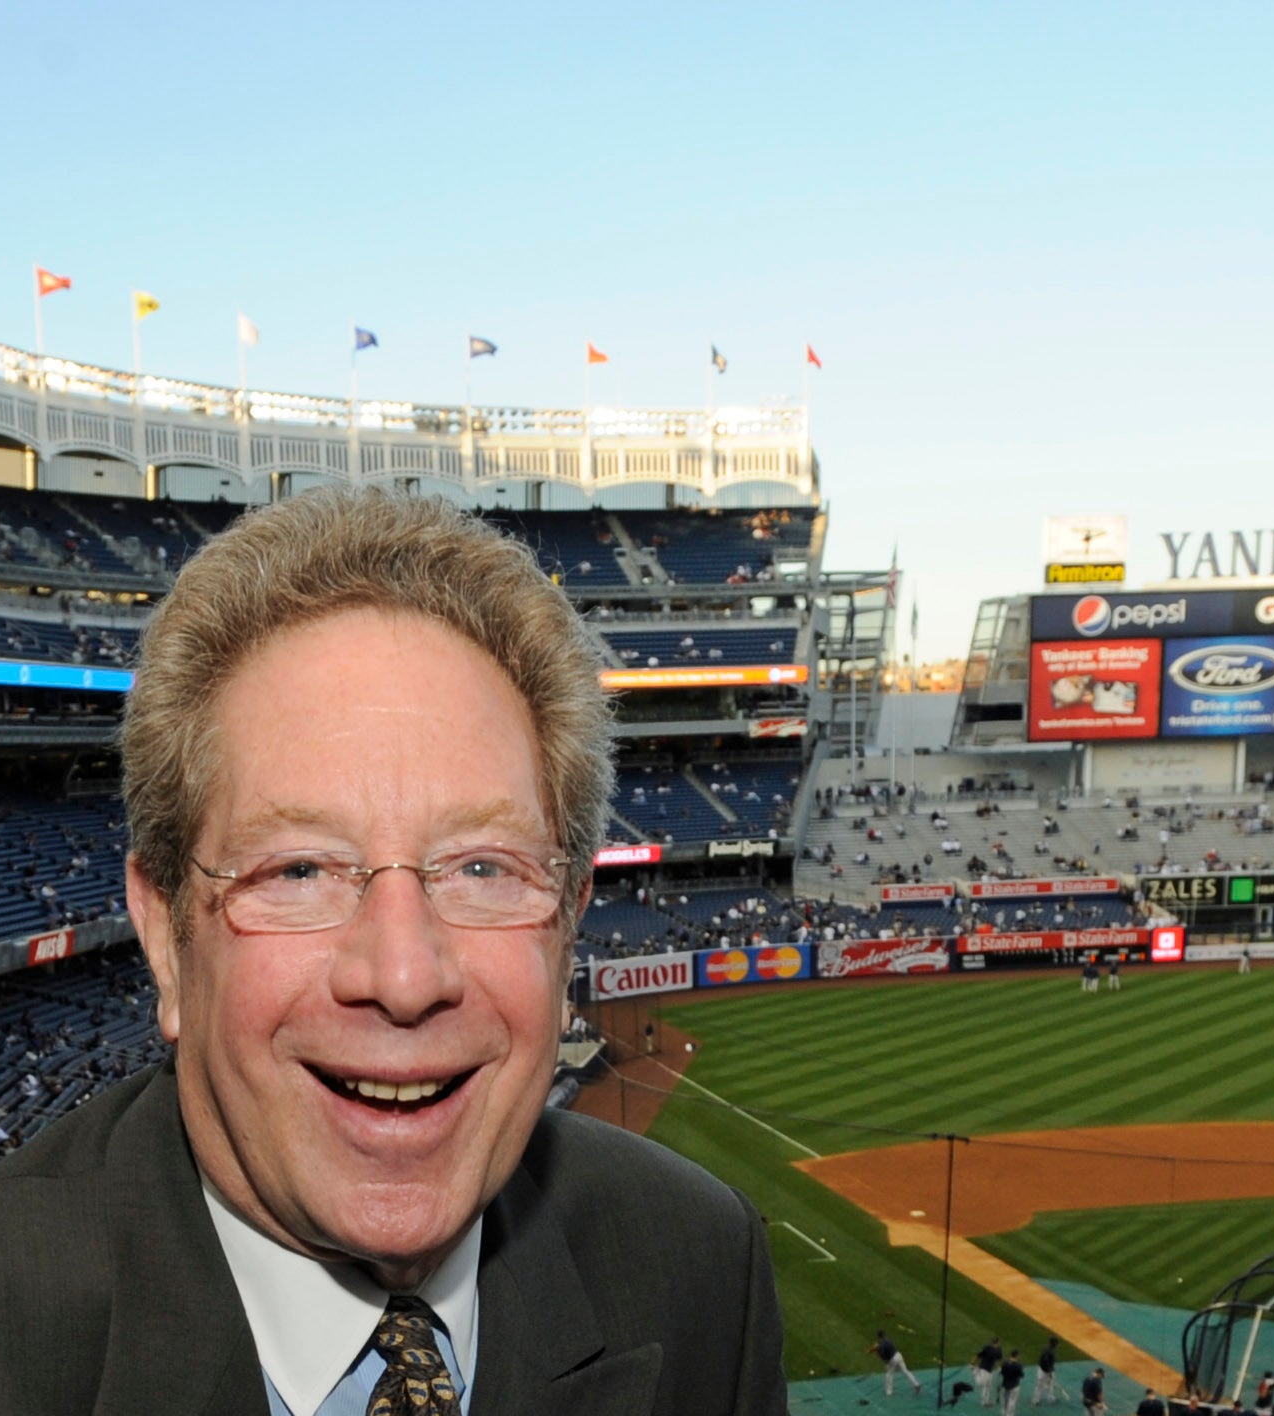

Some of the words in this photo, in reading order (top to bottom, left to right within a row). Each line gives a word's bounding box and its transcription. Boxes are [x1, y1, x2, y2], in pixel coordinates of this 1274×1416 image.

[1047, 564, 1124, 583] Armitron
[1112, 599, 1187, 629] pepsi
[1098, 646, 1149, 663] Banking
[1195, 655, 1264, 685] Ford
[1169, 712, 1271, 727] tristateford.com
[1148, 878, 1218, 899] ZALES
[838, 938, 931, 978] Budweiser
[596, 960, 688, 995] Canon
